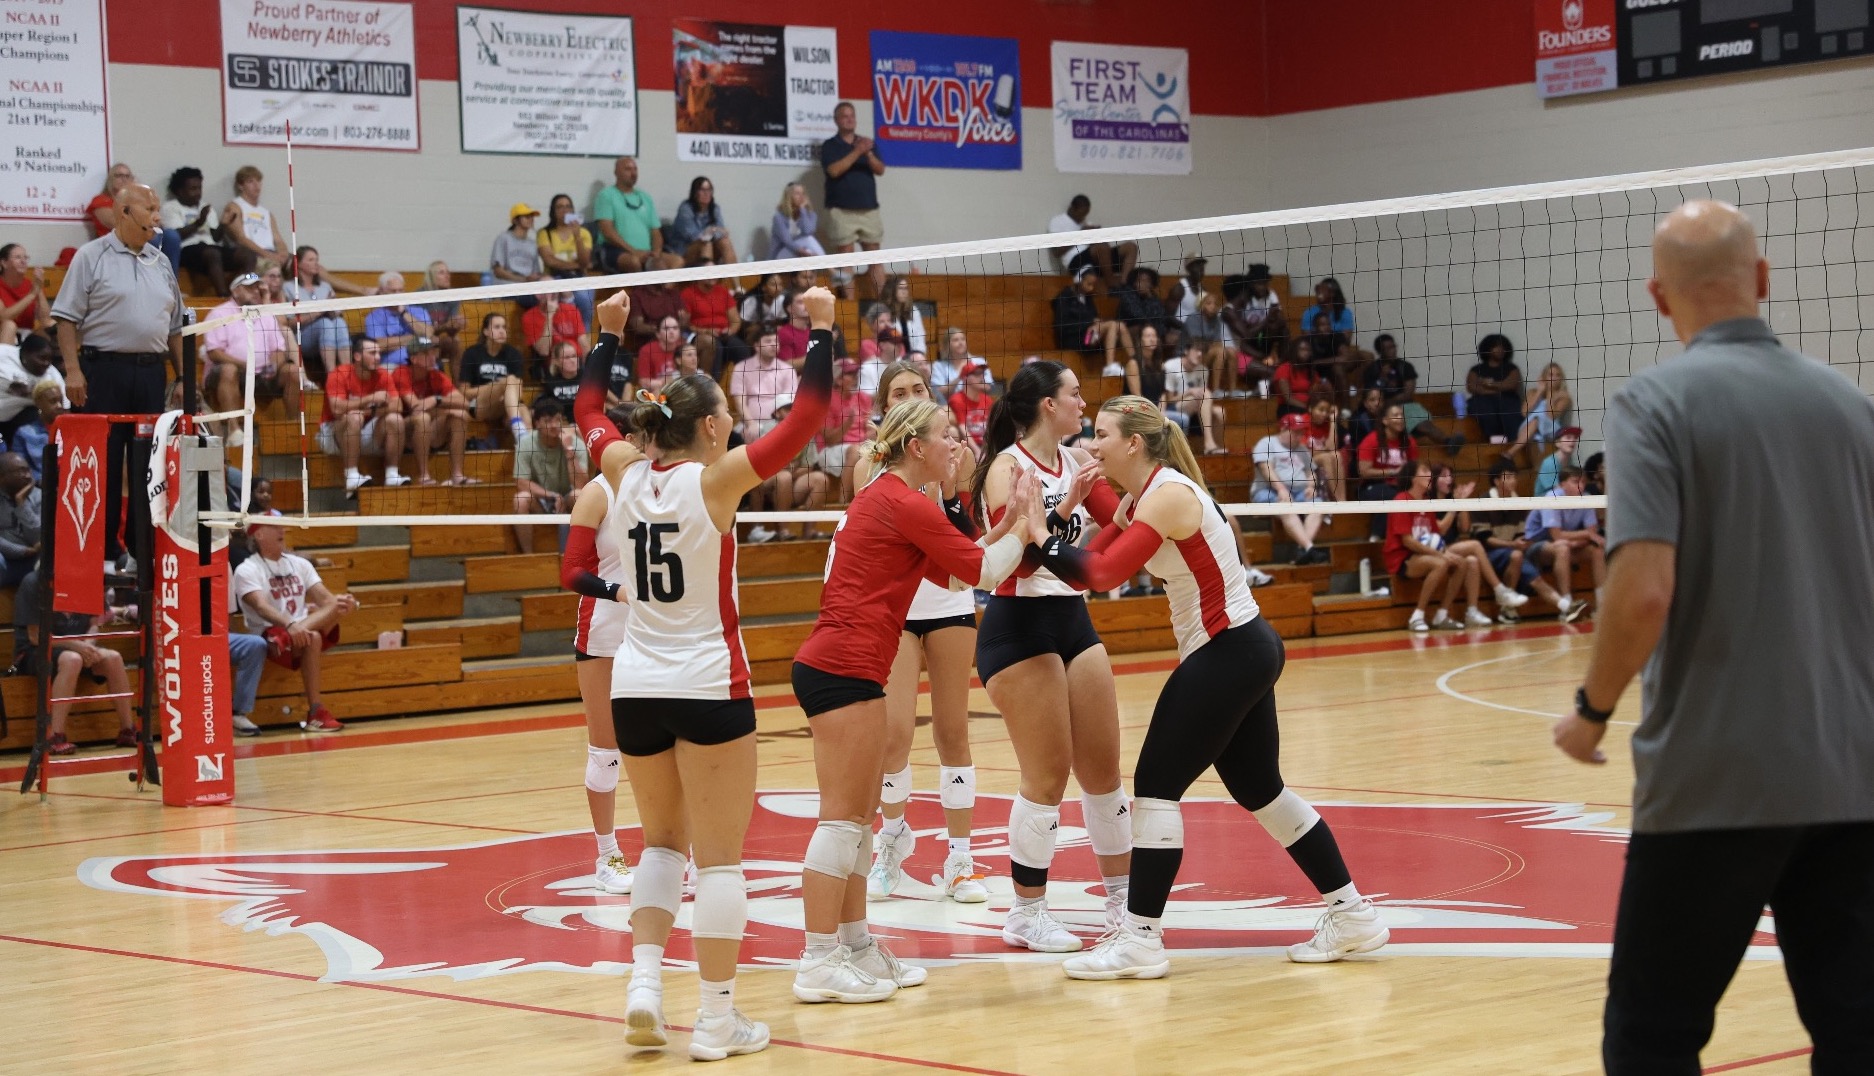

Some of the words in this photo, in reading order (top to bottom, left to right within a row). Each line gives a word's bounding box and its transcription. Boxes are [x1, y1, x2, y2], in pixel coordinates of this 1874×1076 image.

[6, 12, 47, 25] NCAA
[254, 1, 300, 19] Proud
[305, 4, 360, 24] Partner
[364, 9, 380, 25] of
[28, 30, 70, 46] Region
[247, 22, 322, 47] Newberry
[325, 27, 391, 47] Athletics
[490, 22, 562, 48] NEWBERRY
[565, 26, 628, 52] ELECTRIC
[1538, 25, 1611, 50] FOUNDERS
[0, 46, 70, 62] Champions
[792, 47, 831, 64] WILSON
[1699, 39, 1753, 60] PERIOD
[268, 59, 407, 94] STOKES-TRAINOR
[1070, 58, 1140, 81] FIRST
[9, 80, 50, 94] NCAA
[791, 77, 835, 95] TRACTOR
[1071, 81, 1136, 104] TEAM
[19, 98, 105, 115] Championships
[875, 73, 994, 127] WKDK
[7, 113, 30, 126] 21st
[34, 114, 67, 127] Place
[232, 122, 329, 138] stokestraior.com
[956, 106, 1015, 148] Voice
[1075, 125, 1089, 138] OF
[16, 146, 61, 159] Ranked
[690, 140, 711, 158] 440
[714, 142, 752, 160] WILSON
[25, 160, 87, 177] Nationally
[26, 186, 38, 198] 12
[50, 186, 56, 199] 2
[628, 521, 684, 603] 15
[162, 554, 182, 747] WOLVES
[200, 655, 213, 694] sports
[202, 696, 215, 745] imports
